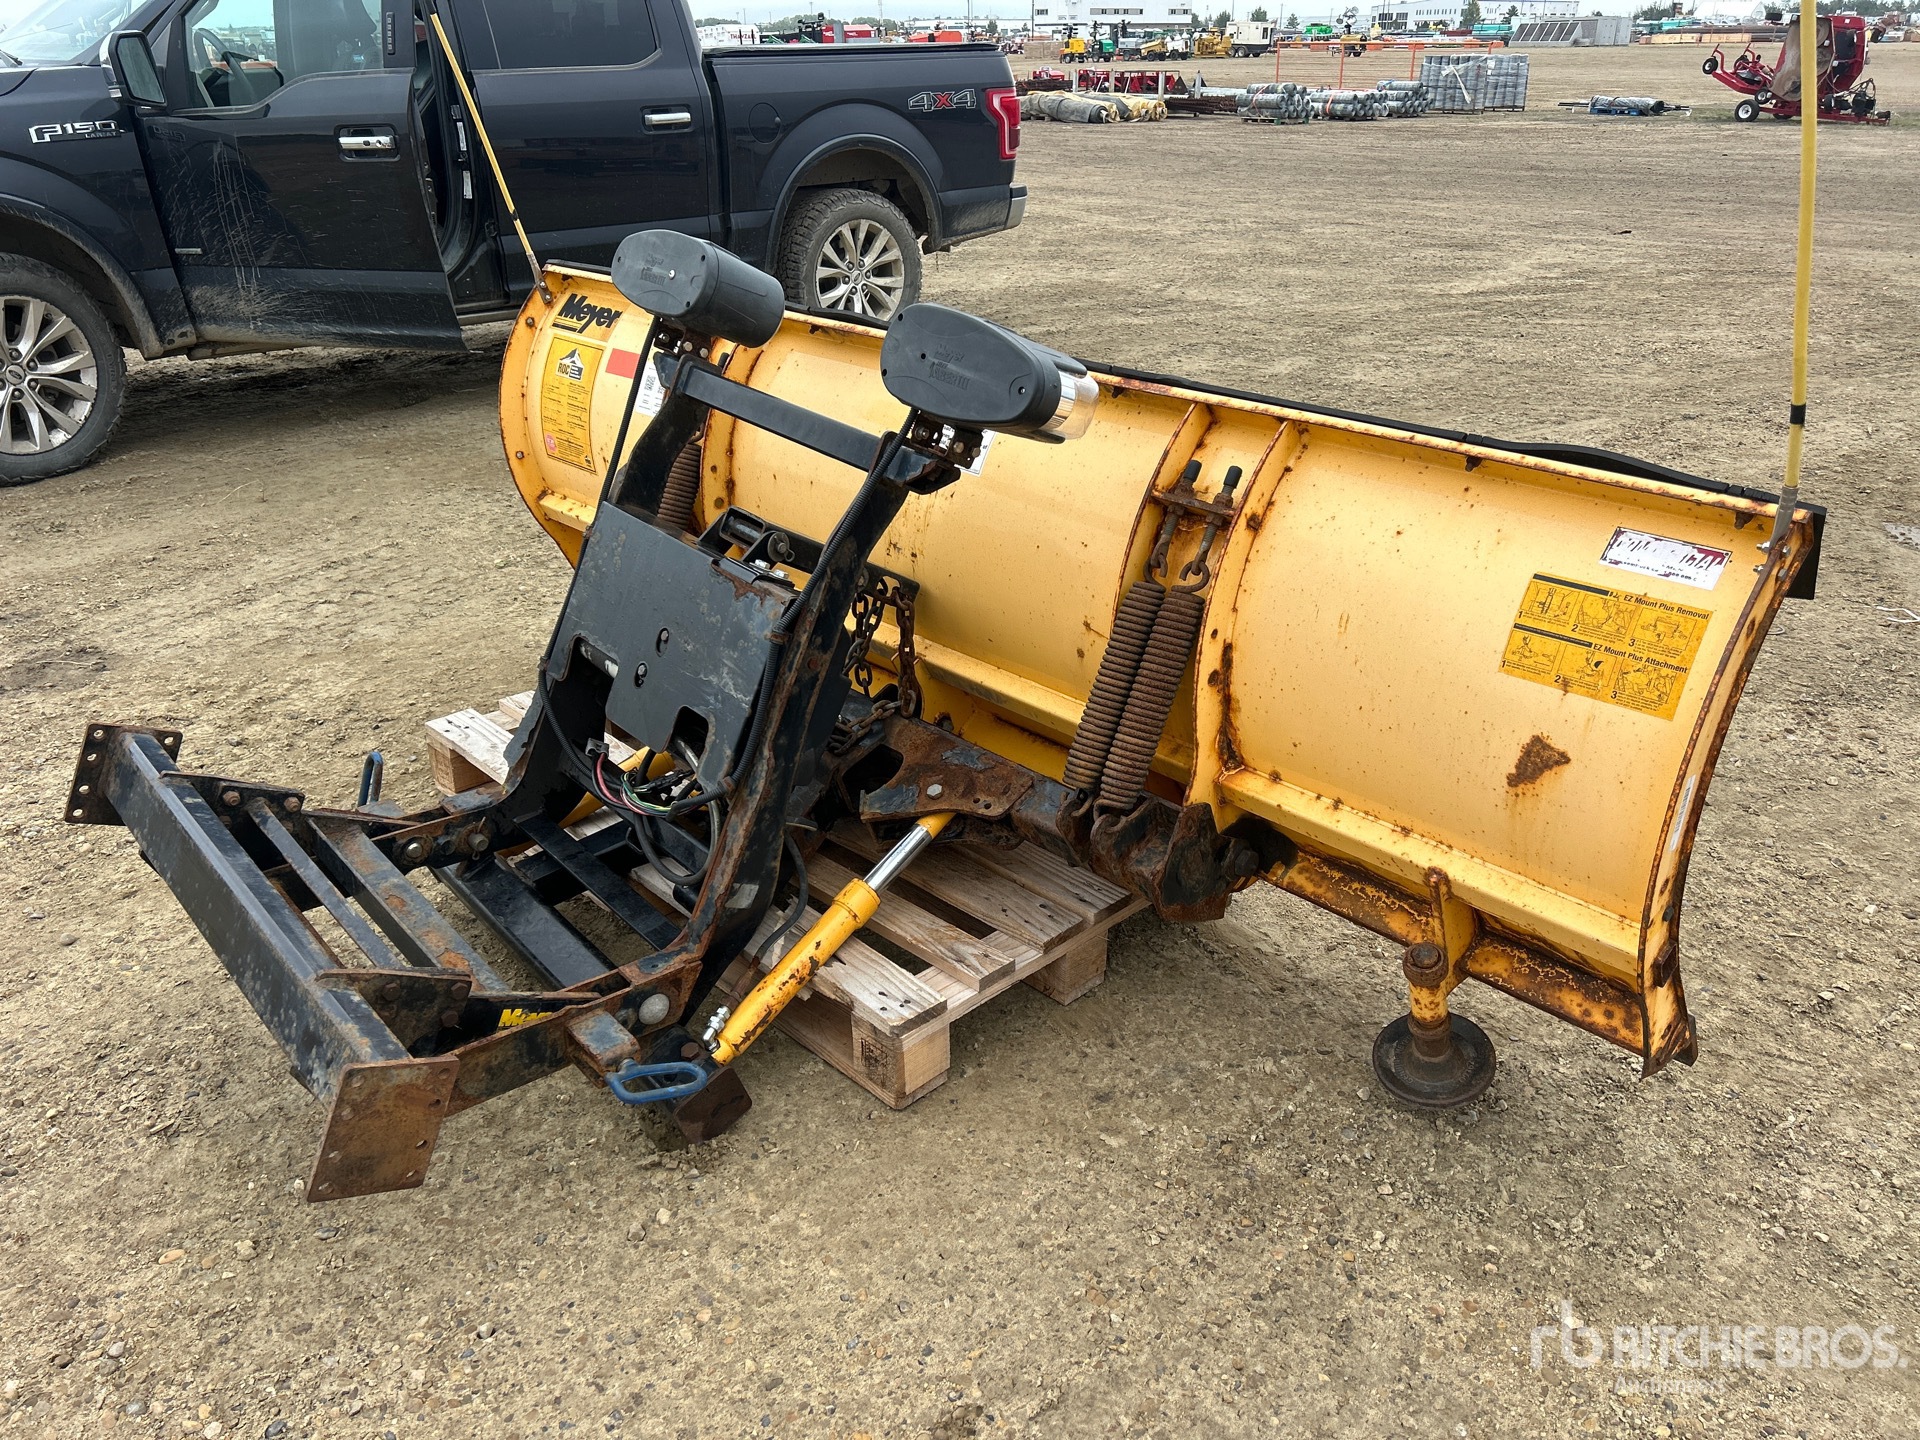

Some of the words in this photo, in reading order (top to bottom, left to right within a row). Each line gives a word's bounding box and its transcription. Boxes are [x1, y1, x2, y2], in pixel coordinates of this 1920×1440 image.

[85, 131, 117, 139] LARIAT
[557, 293, 623, 334] Meyer
[1623, 594, 1634, 602] EZ
[1634, 597, 1659, 608] Mount
[1658, 602, 1676, 612] Plus
[1676, 606, 1710, 620] Removal
[1518, 611, 1523, 619] 1
[1571, 624, 1579, 633] 2
[1628, 638, 1636, 647] 3
[1593, 644, 1604, 652] EZ
[1603, 646, 1627, 658] Mount
[1627, 652, 1644, 662] Plus
[1644, 657, 1689, 674] Attachment
[1501, 660, 1507, 669] 1
[1553, 674, 1562, 684] 2
[1610, 690, 1618, 700] 3
